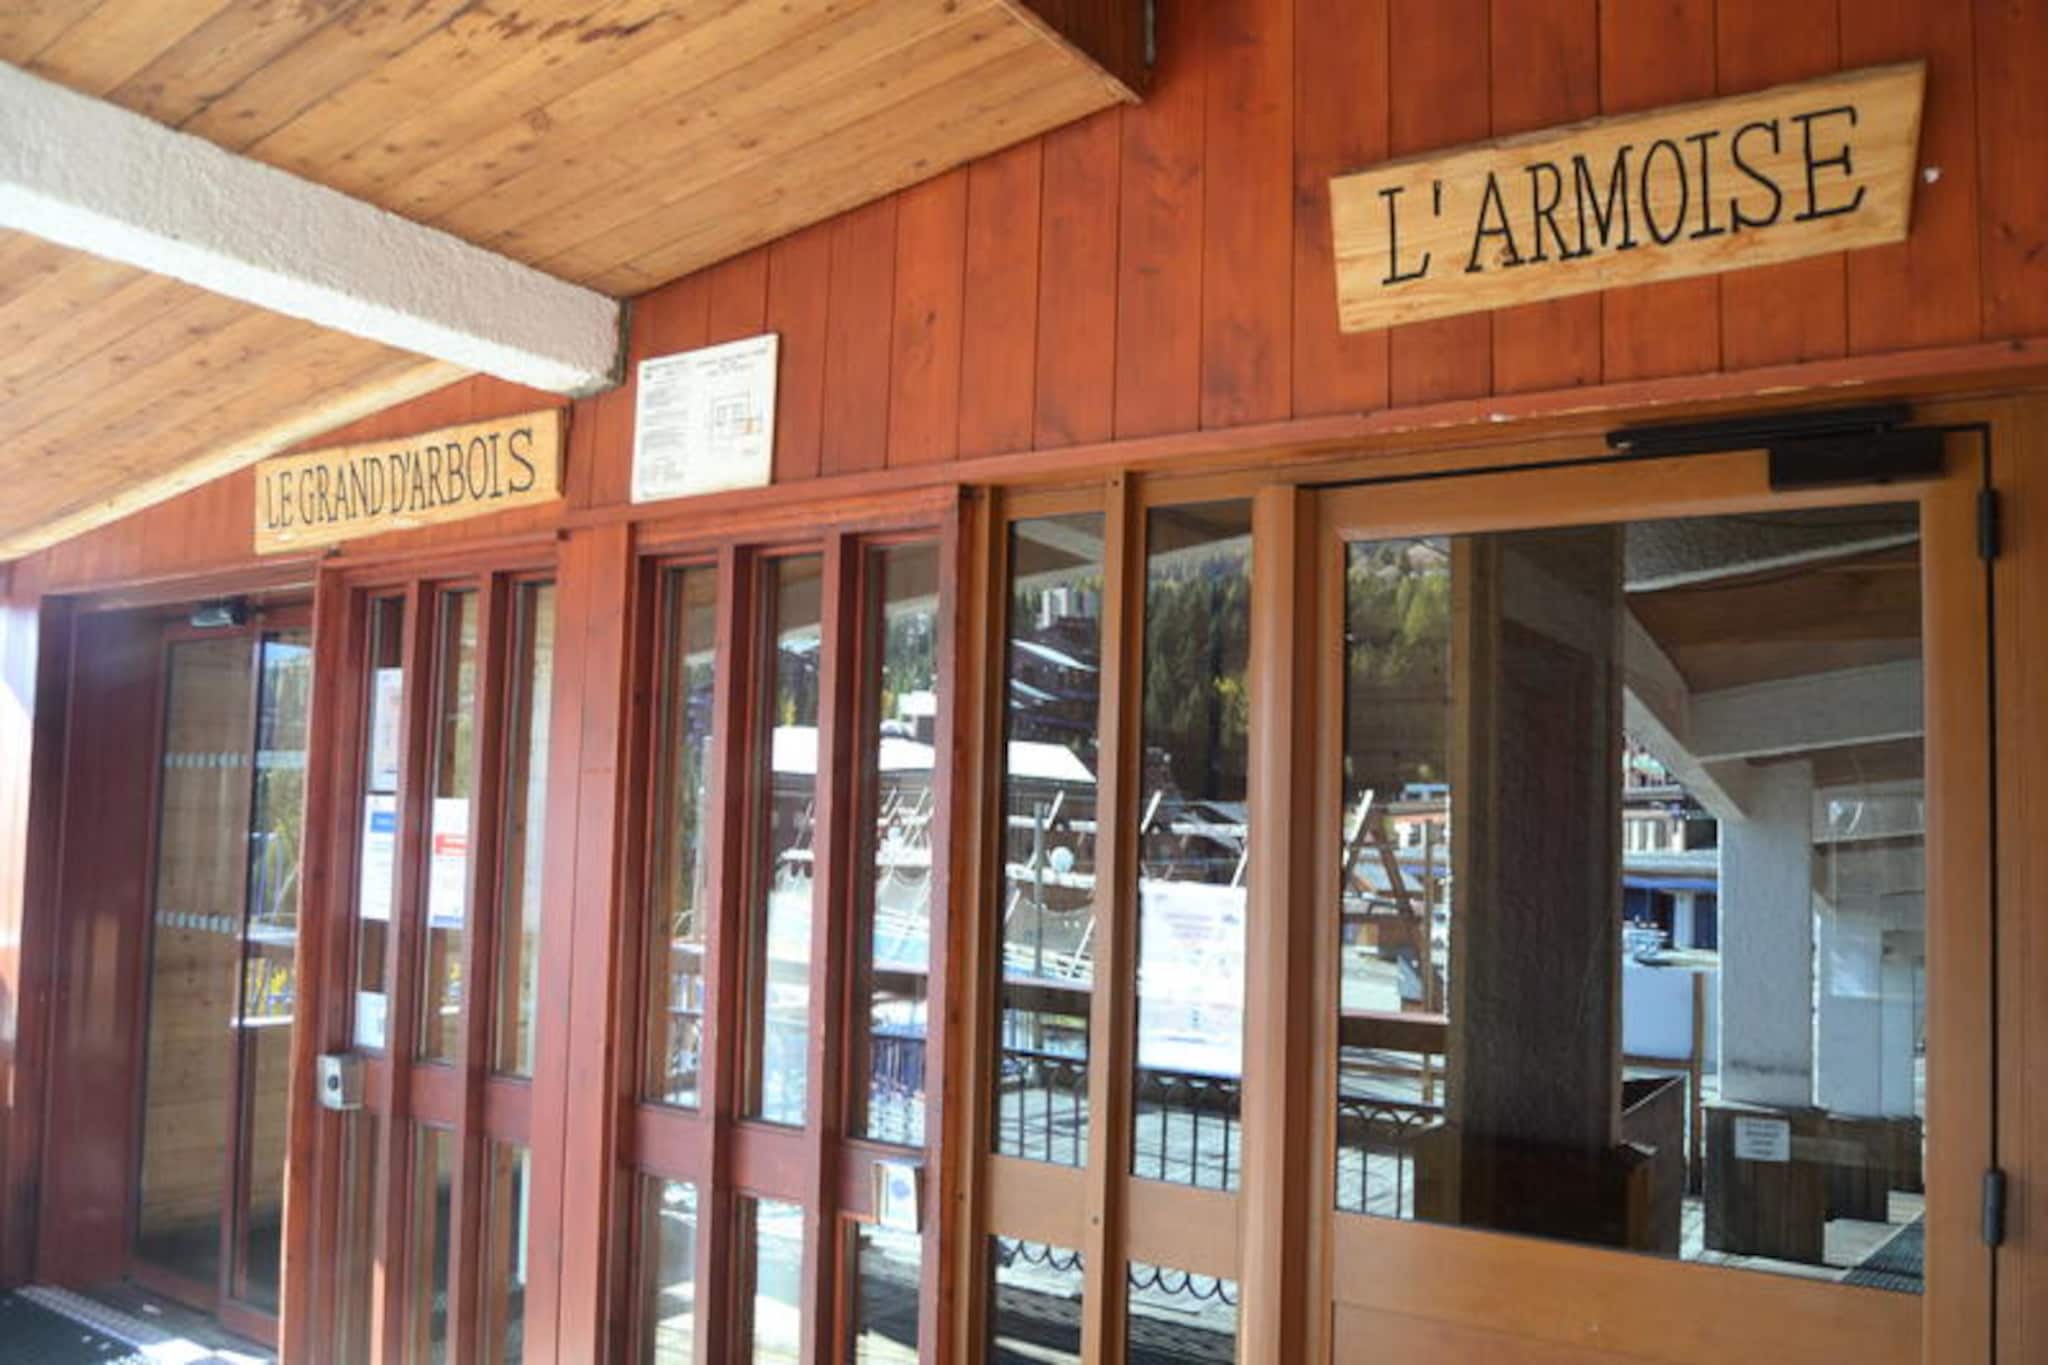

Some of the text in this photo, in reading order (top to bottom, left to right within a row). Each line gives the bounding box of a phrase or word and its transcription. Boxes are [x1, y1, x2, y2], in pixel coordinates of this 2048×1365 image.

[265, 428, 536, 529] LE GRAND D'ARBOIS
